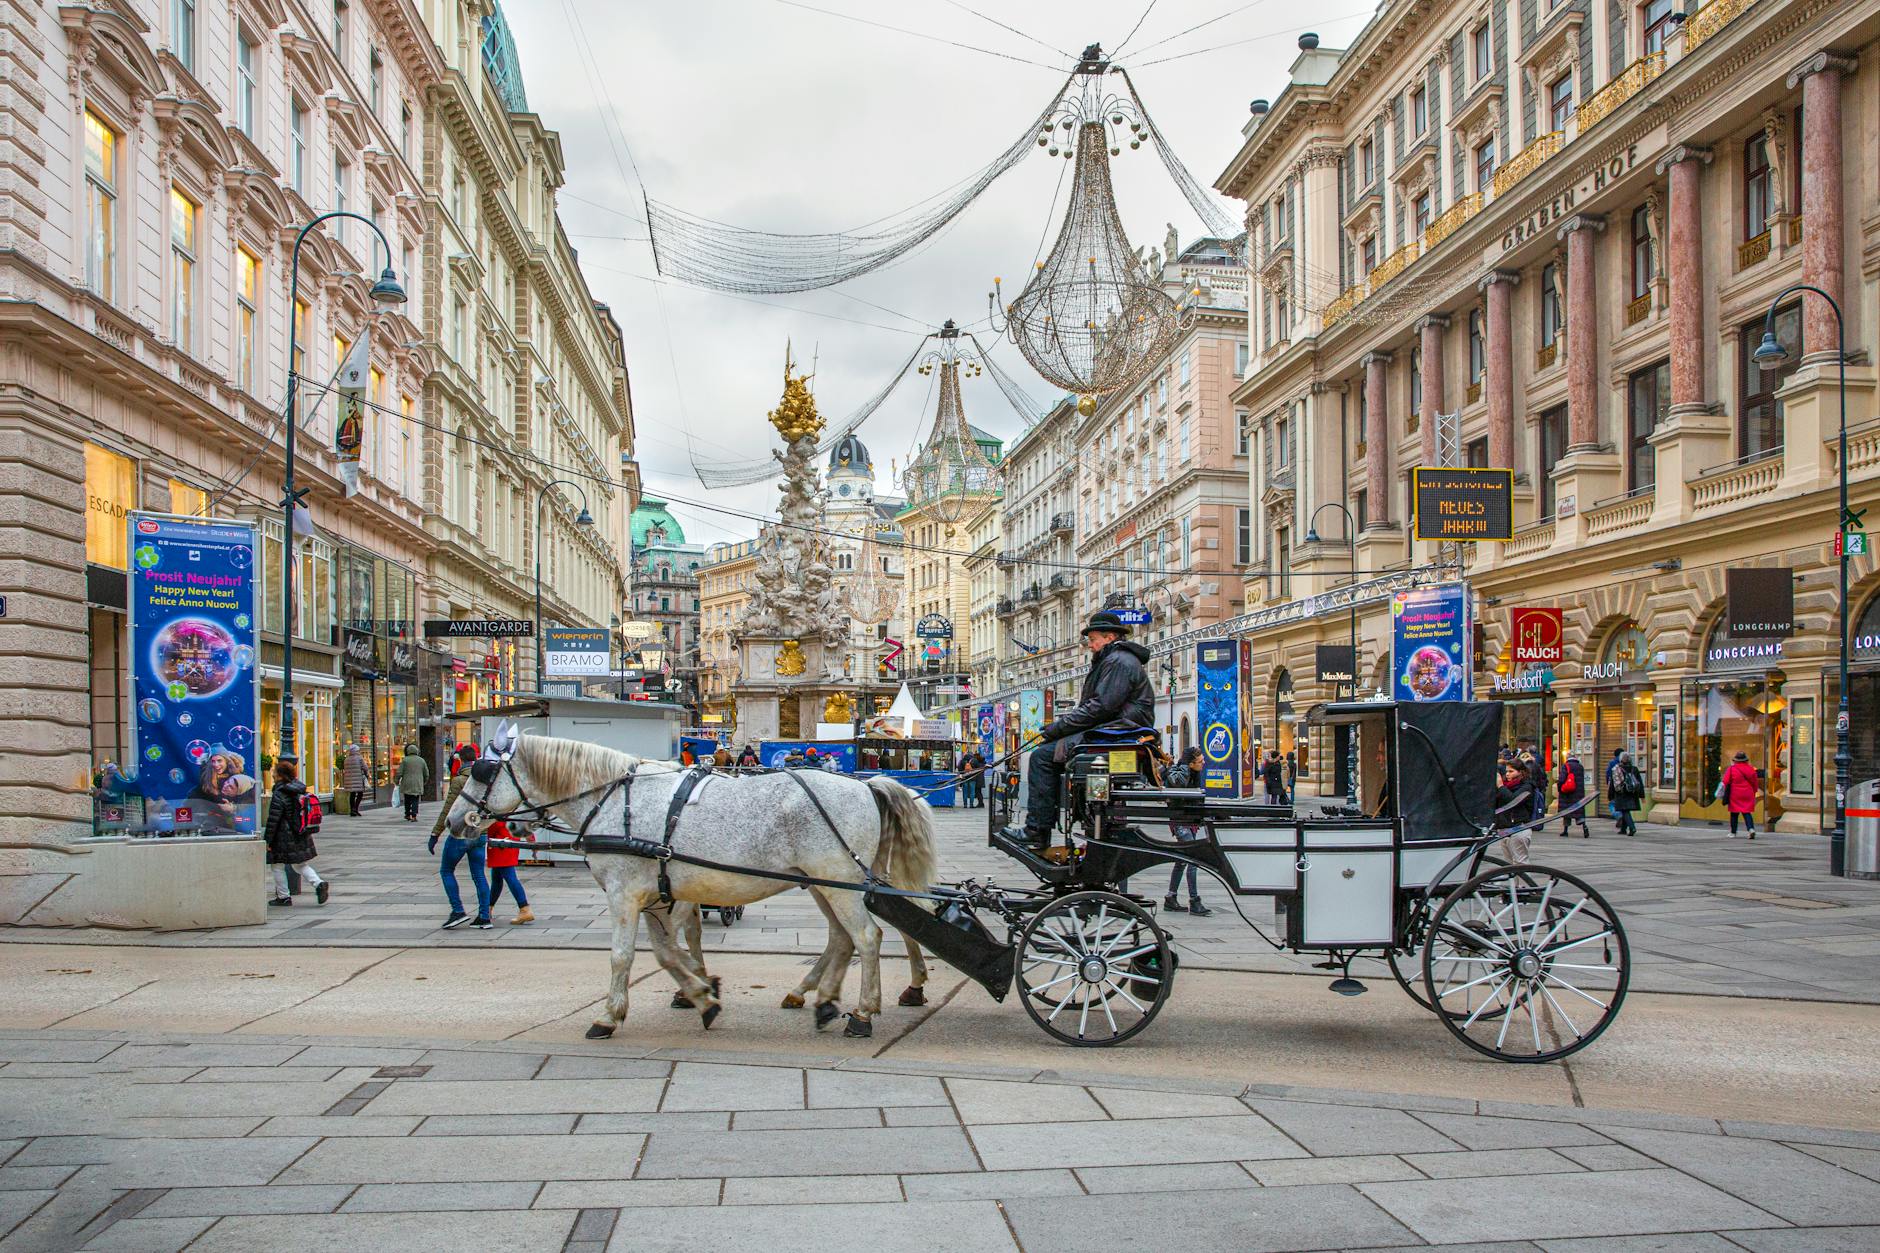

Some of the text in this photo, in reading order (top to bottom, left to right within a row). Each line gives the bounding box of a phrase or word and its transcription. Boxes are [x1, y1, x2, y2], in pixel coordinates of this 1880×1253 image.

[1502, 189, 1574, 251] GRABEN
[1594, 144, 1637, 192] HOF
[145, 569, 242, 588] Prosit Neujahr!
[154, 585, 234, 598] Happy New Year!
[149, 596, 239, 609] Felice Anno Nuovo!
[1402, 609, 1455, 622] Prosit Neujahr!
[449, 621, 530, 632] AVANTGARDE
[1406, 624, 1423, 632] Happy
[1733, 622, 1791, 631] LONGCHAMP
[551, 632, 604, 640] wienerin
[1434, 629, 1453, 637] Nuovo!
[1517, 647, 1560, 659] RAUCH
[1709, 643, 1783, 661] LONGCHAMP
[552, 654, 604, 666] BRAMO
[1321, 671, 1352, 680] MaxMara
[1584, 662, 1623, 680] RAUCH
[1493, 669, 1544, 692] Wellendorff
